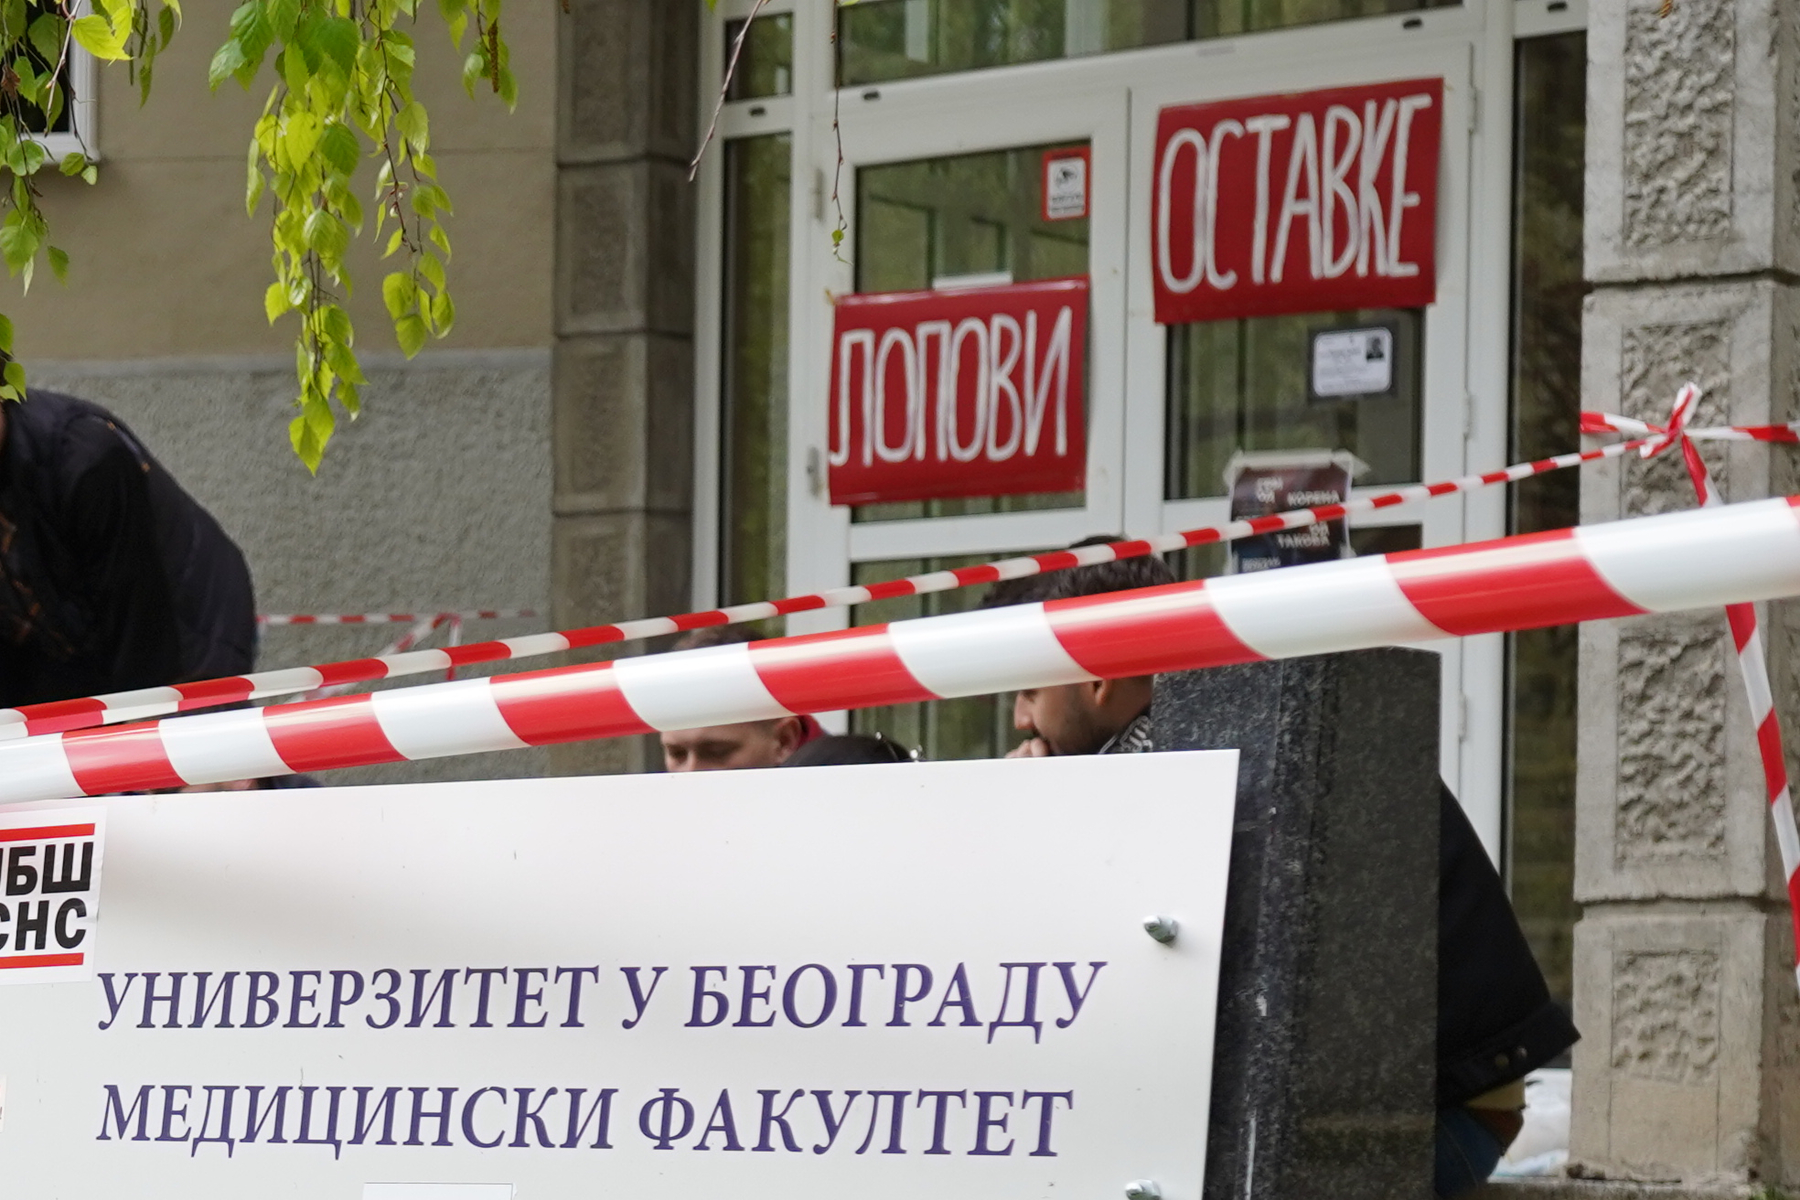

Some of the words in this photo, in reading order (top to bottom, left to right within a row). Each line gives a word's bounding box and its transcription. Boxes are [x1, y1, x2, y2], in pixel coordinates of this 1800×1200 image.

[1157, 92, 1433, 294] ОСТАВКЕ
[829, 304, 1073, 467] ЛОПОВИ
[96, 965, 601, 1031] УНИВЕРЗИТЕТ
[619, 965, 670, 1031] У
[682, 961, 1108, 1046] БЕОГРАДУ
[95, 1084, 620, 1161] МЕДИЦИНСКИ
[637, 1087, 1075, 1158] ФАКУЛТЕТ
